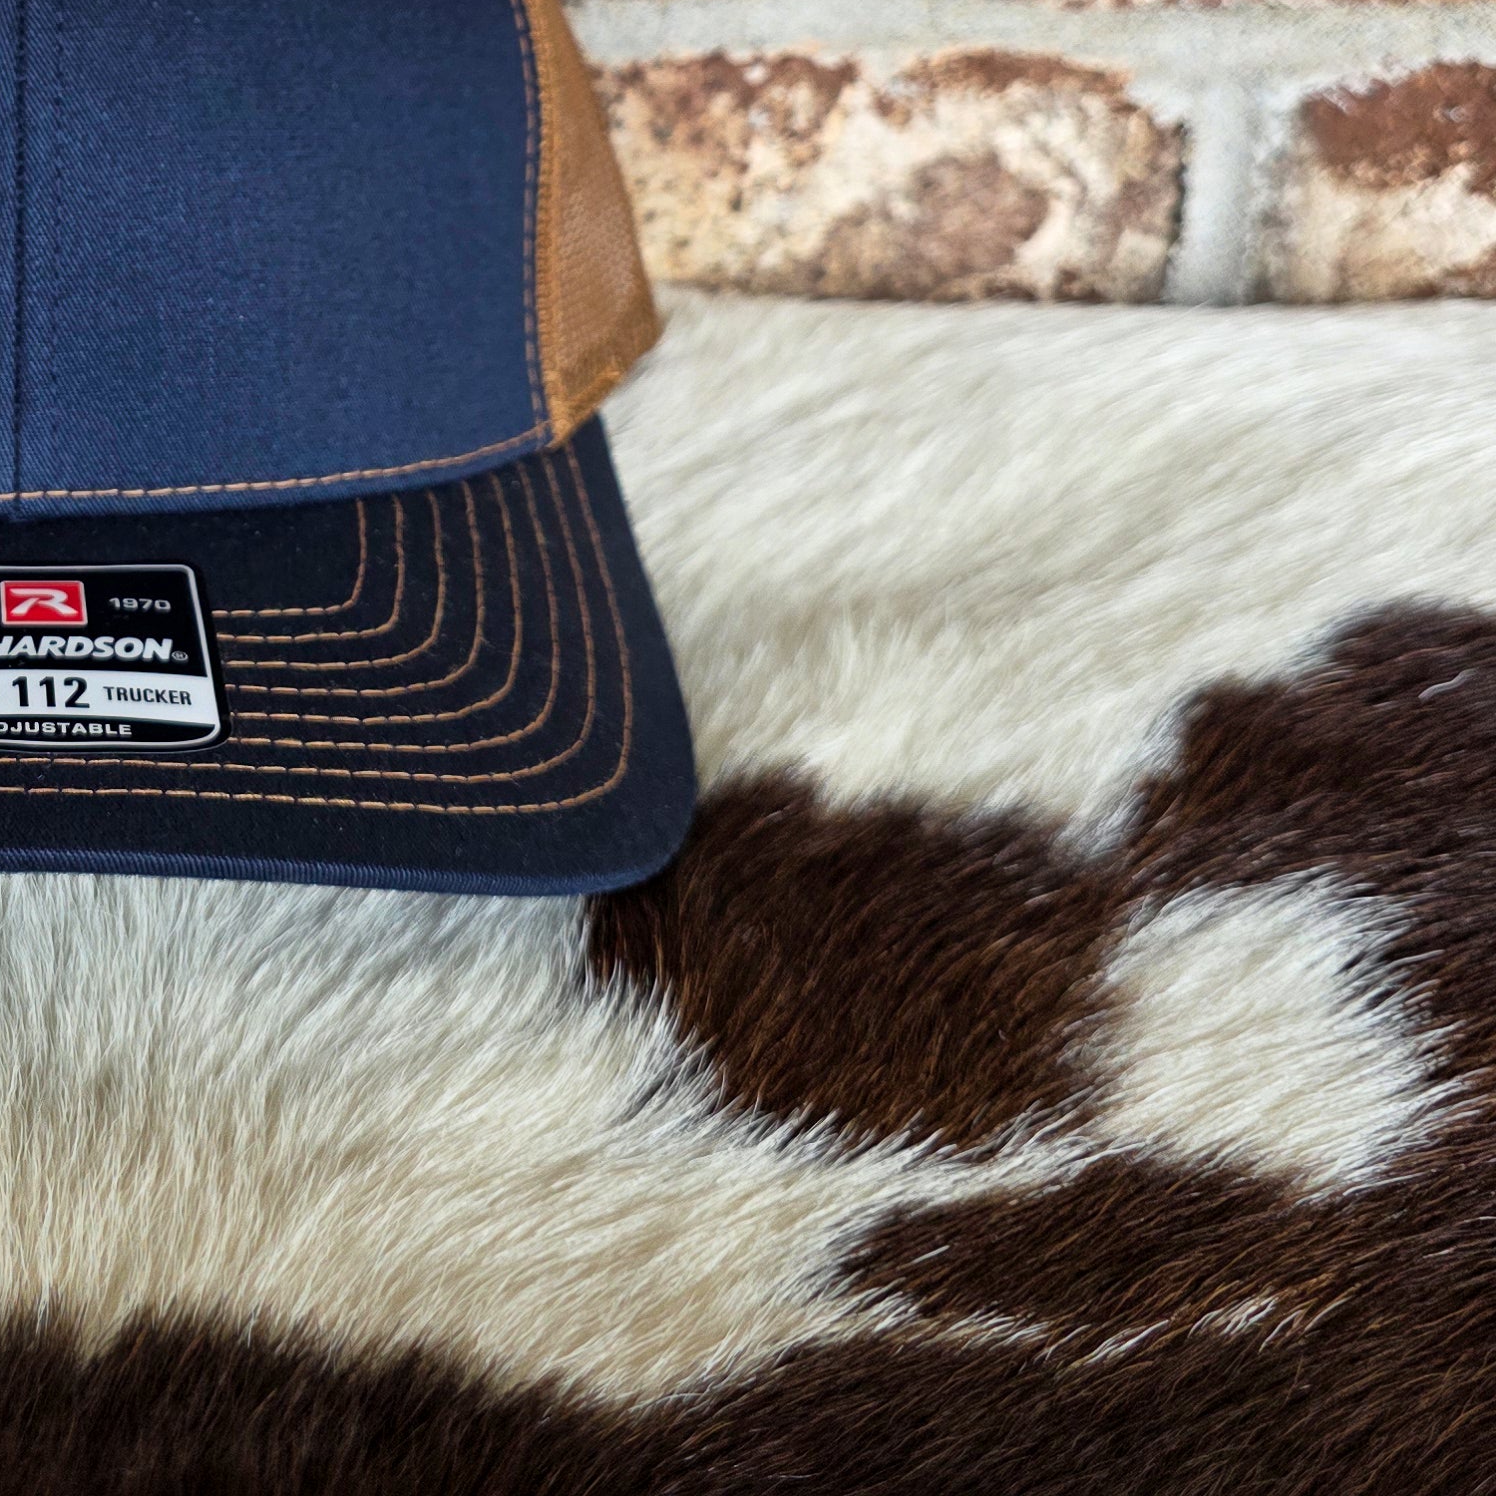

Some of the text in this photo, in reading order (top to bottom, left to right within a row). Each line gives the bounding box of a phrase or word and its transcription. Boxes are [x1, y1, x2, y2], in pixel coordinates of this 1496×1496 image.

[108, 597, 171, 611] 1970
[12, 676, 90, 709] 112
[103, 685, 192, 705] TRUCKER
